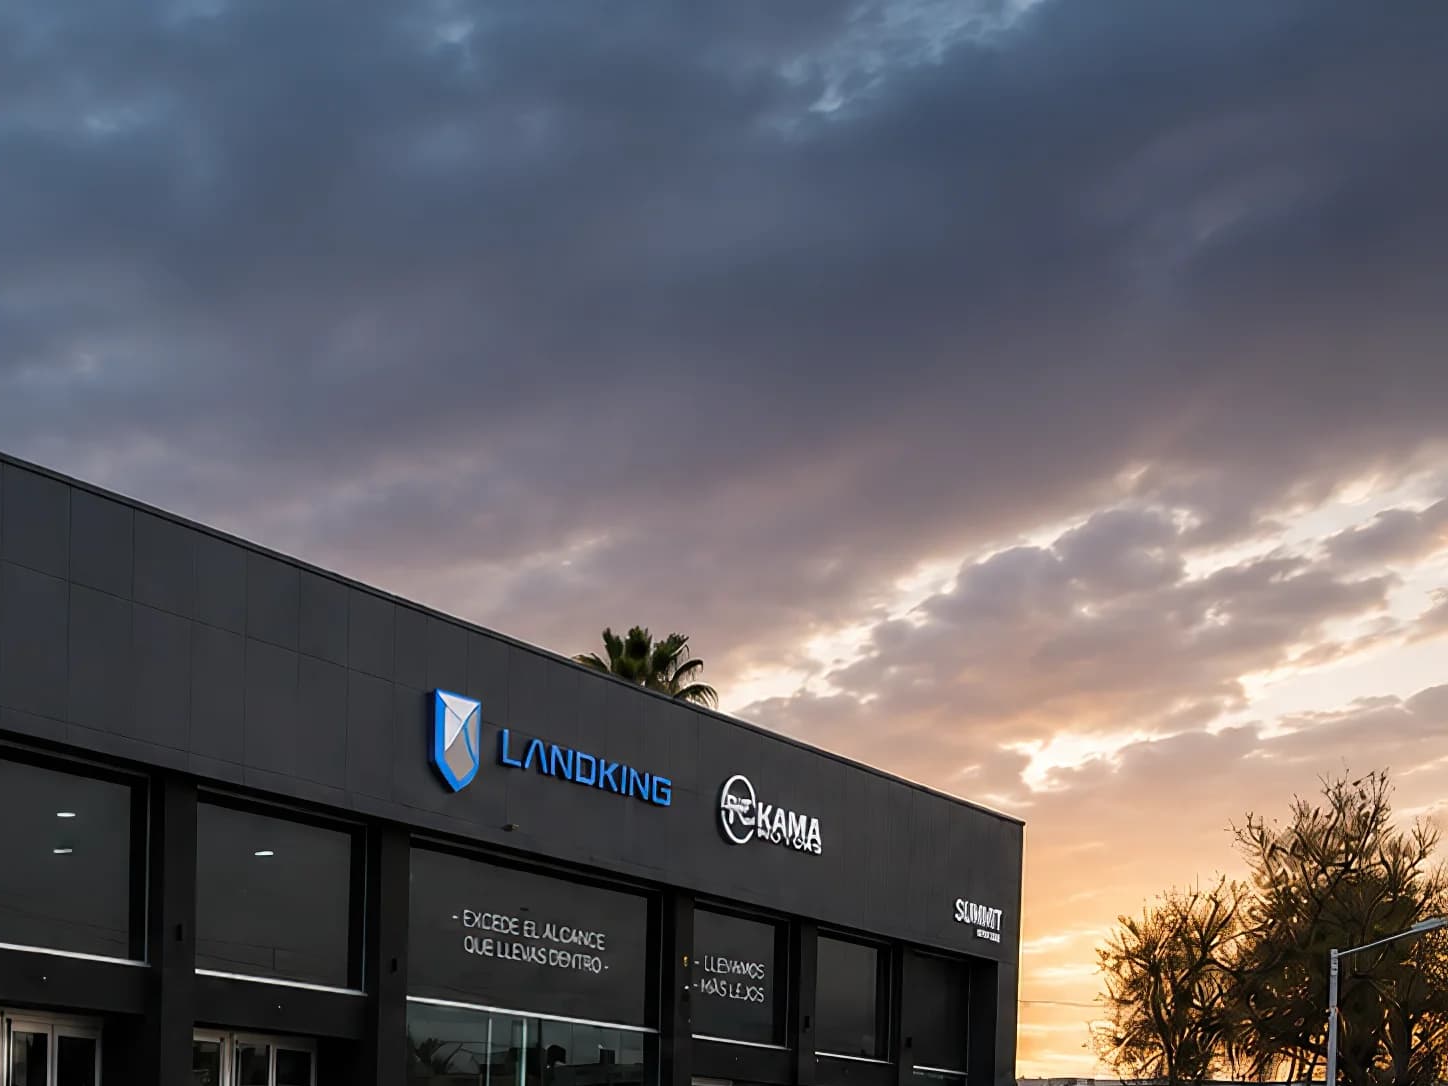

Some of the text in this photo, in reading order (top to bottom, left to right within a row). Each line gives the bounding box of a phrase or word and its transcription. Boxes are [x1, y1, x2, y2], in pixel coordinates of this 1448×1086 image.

[501, 728, 672, 806] LANDKING
[757, 801, 822, 845] KAMA
[463, 909, 520, 936] EXCEDE
[523, 920, 540, 939] EL
[463, 935, 494, 957] QUE
